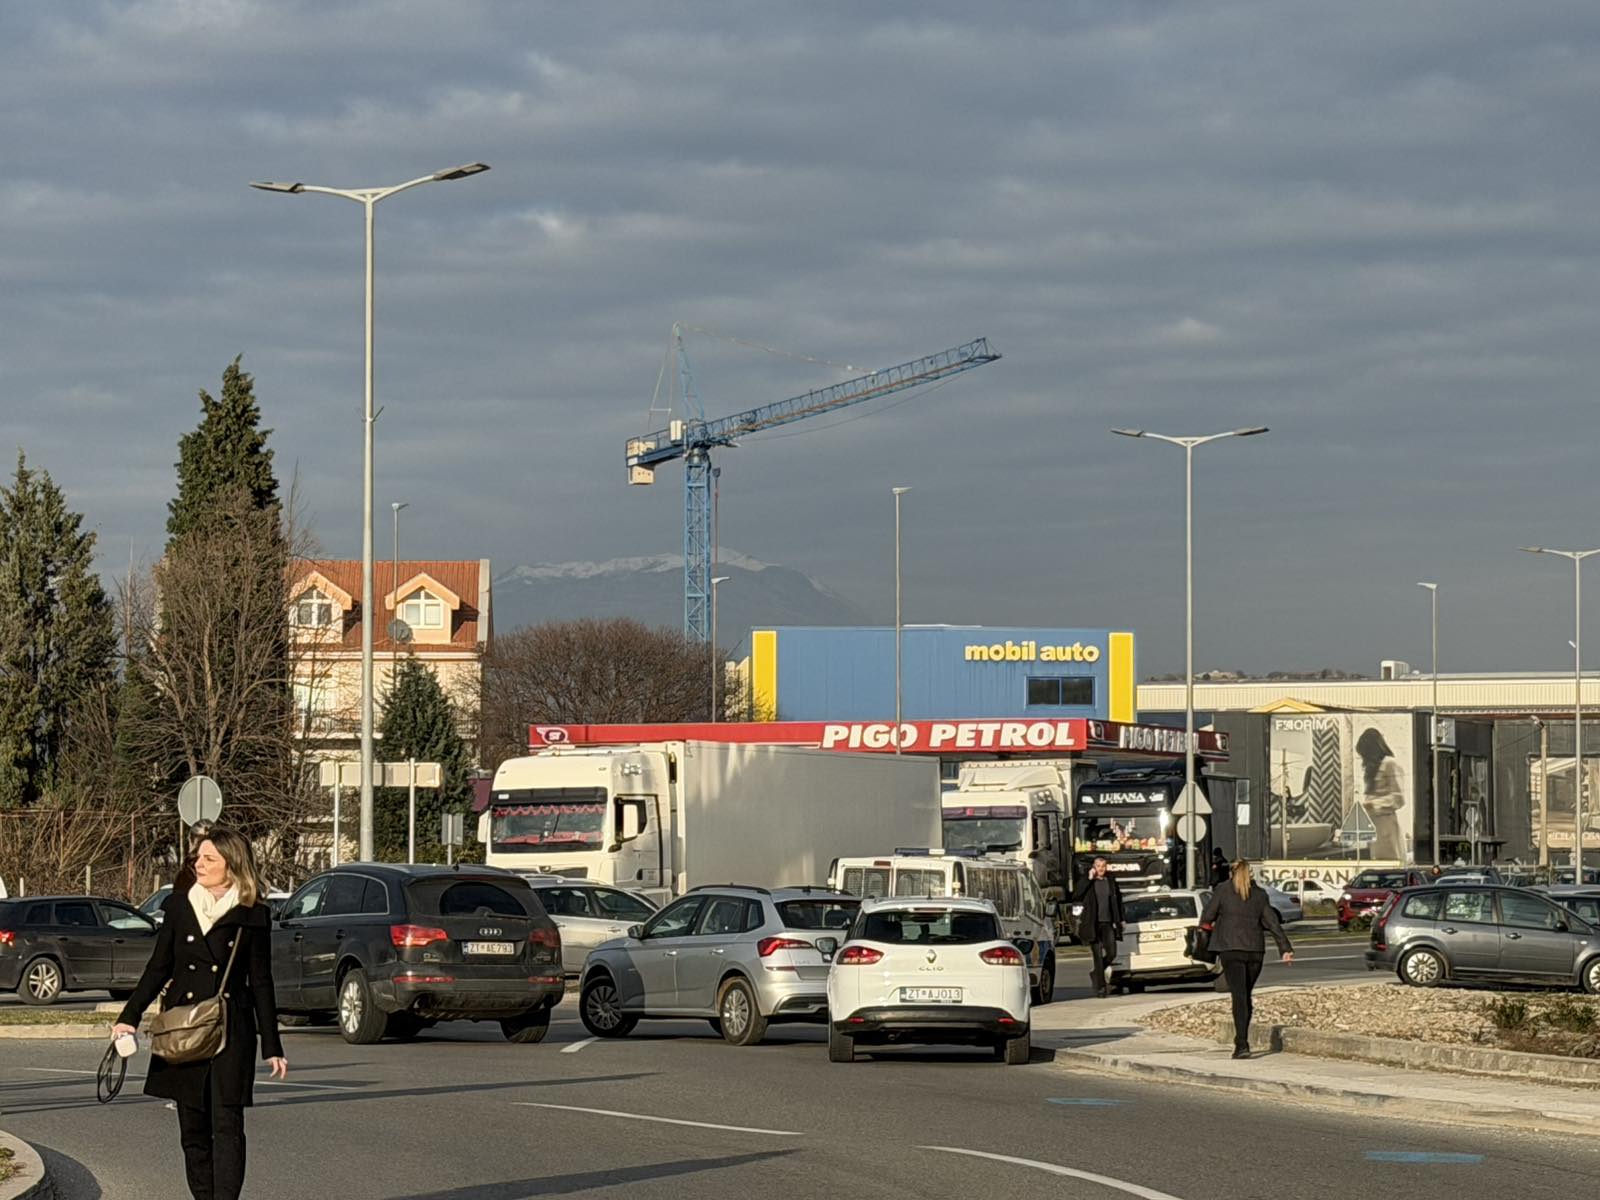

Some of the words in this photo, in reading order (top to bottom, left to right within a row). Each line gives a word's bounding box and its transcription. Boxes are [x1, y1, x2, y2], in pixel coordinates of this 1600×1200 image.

[965, 640, 1036, 661] mobil
[1040, 642, 1099, 662] auto
[822, 723, 918, 749] PIGO
[929, 722, 1075, 748] PETROL
[1099, 792, 1147, 804] LUKANA
[908, 990, 920, 999] ZT
